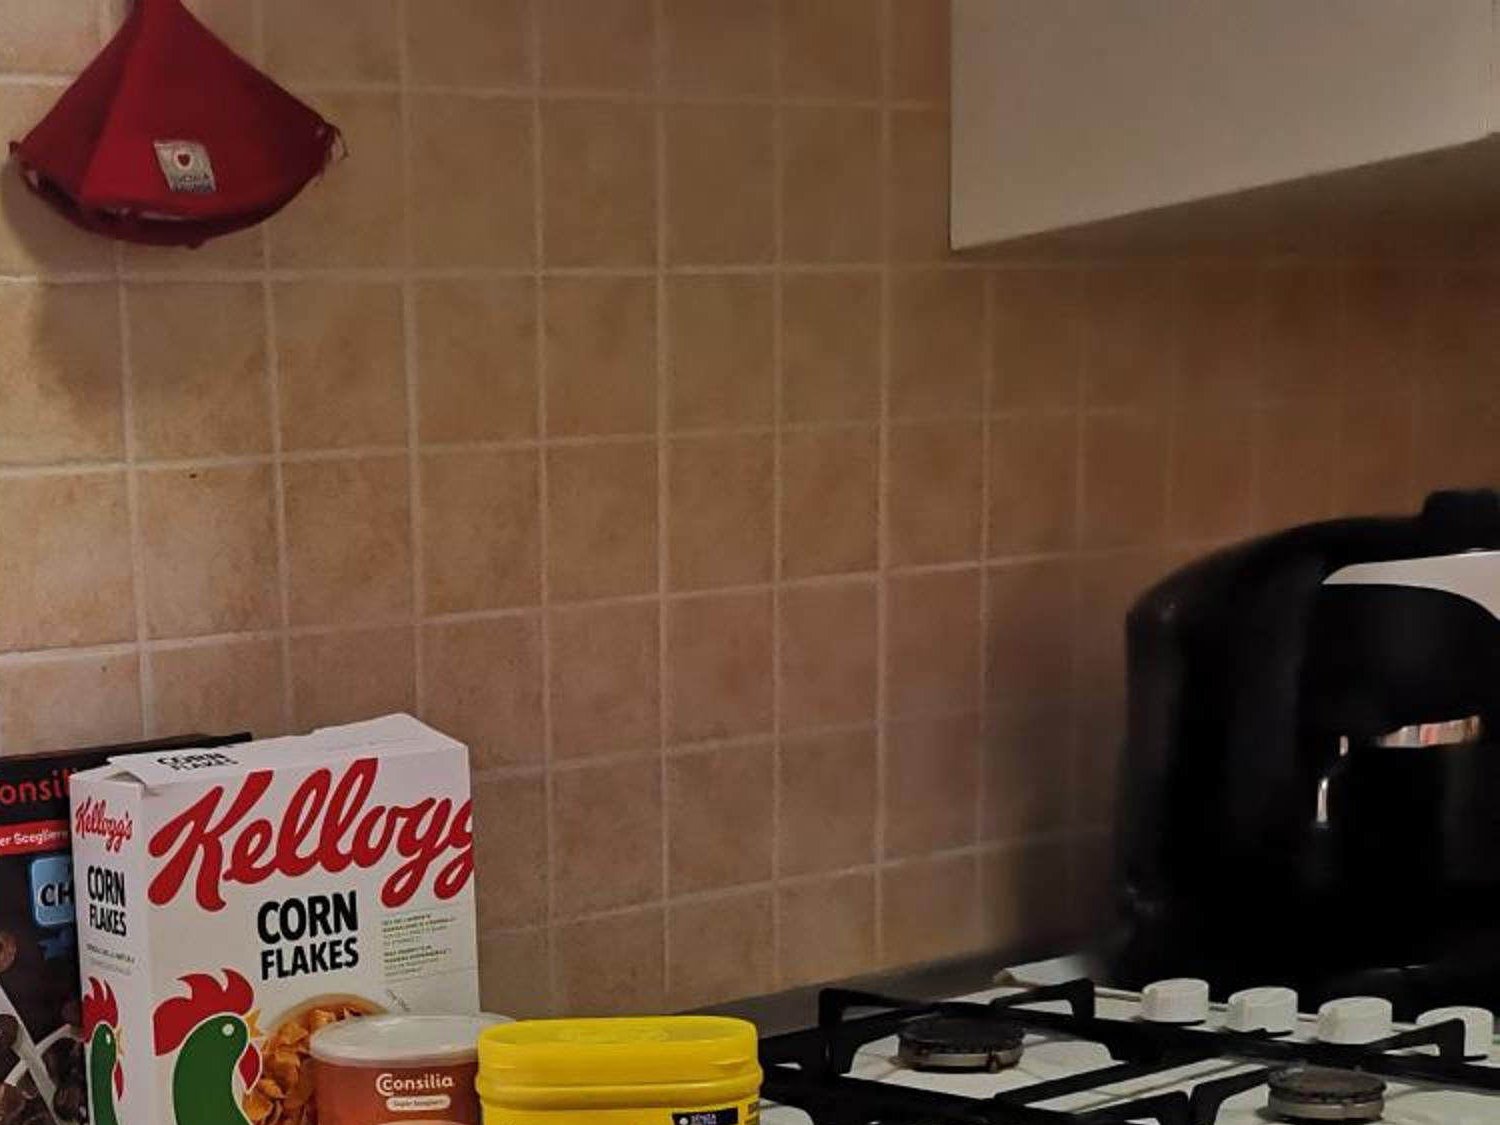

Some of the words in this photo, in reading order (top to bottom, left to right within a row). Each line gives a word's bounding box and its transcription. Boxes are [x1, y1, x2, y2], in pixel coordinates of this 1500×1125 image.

[76, 796, 133, 852] Kellogg's
[87, 865, 127, 906] CORN
[89, 903, 127, 938] FLAKES
[256, 890, 359, 945] CORN
[260, 936, 359, 981] FLAKES
